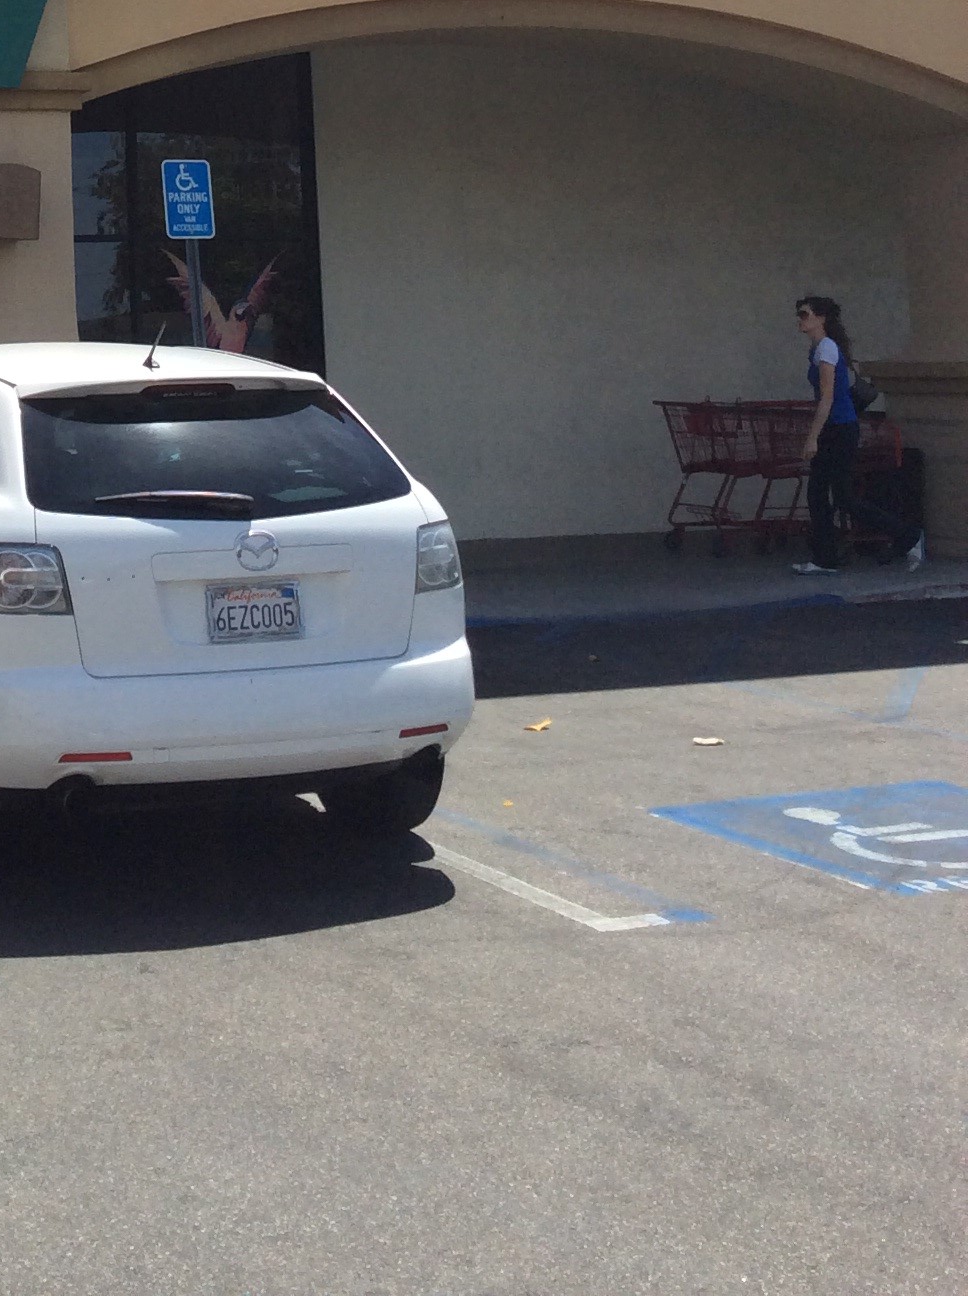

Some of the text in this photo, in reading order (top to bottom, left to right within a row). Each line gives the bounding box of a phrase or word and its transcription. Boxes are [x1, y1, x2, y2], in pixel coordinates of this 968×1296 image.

[168, 191, 208, 203] PARKING
[177, 203, 200, 215] ONLY
[225, 587, 279, 603] California
[216, 602, 295, 632] 6EZC005
